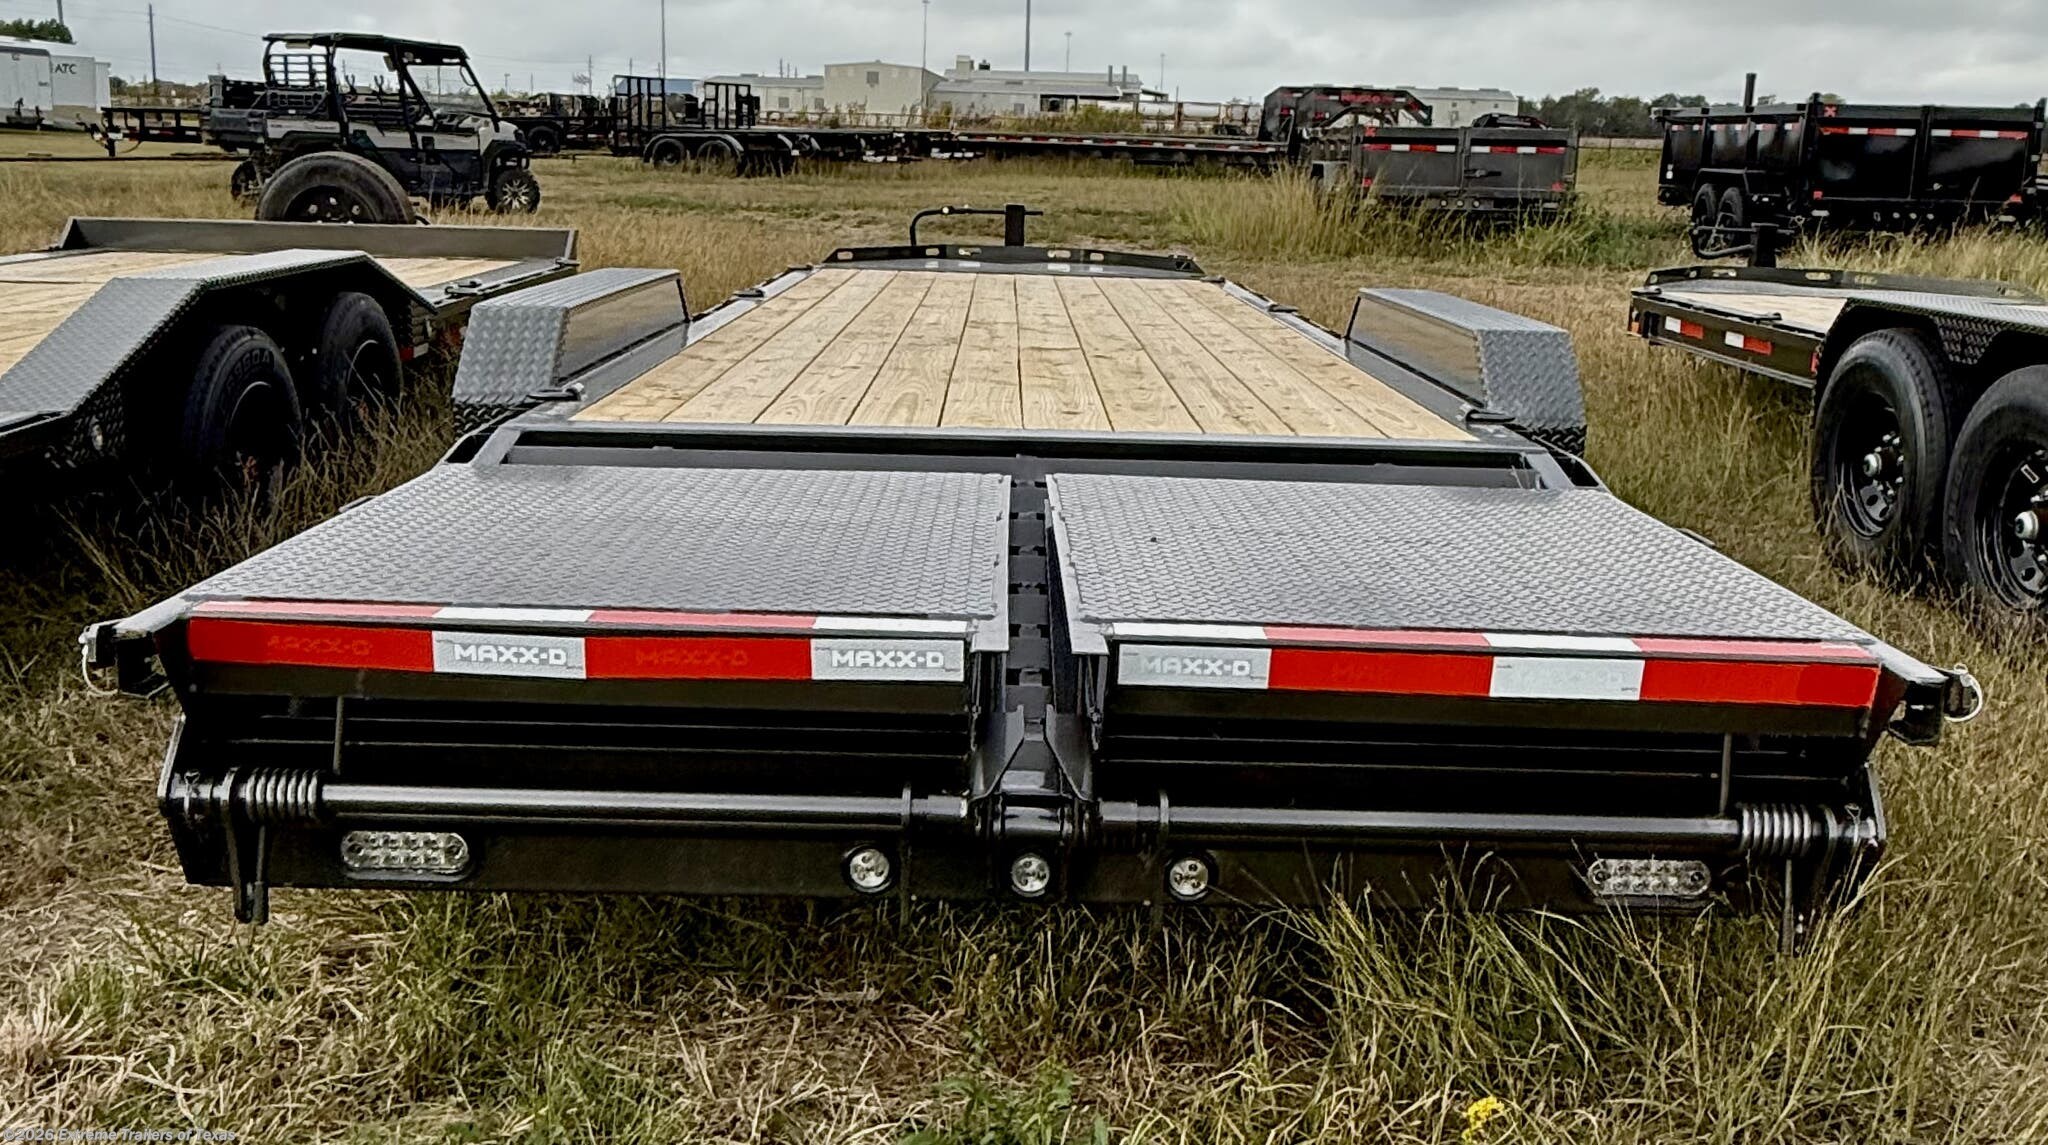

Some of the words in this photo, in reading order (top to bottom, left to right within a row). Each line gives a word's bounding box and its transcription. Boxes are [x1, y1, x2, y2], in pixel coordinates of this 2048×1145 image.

[54, 63, 78, 75] ATC
[453, 643, 567, 666] MAXX-D
[831, 649, 945, 668] MAXX-D
[1140, 656, 1251, 677] MAXX-D
